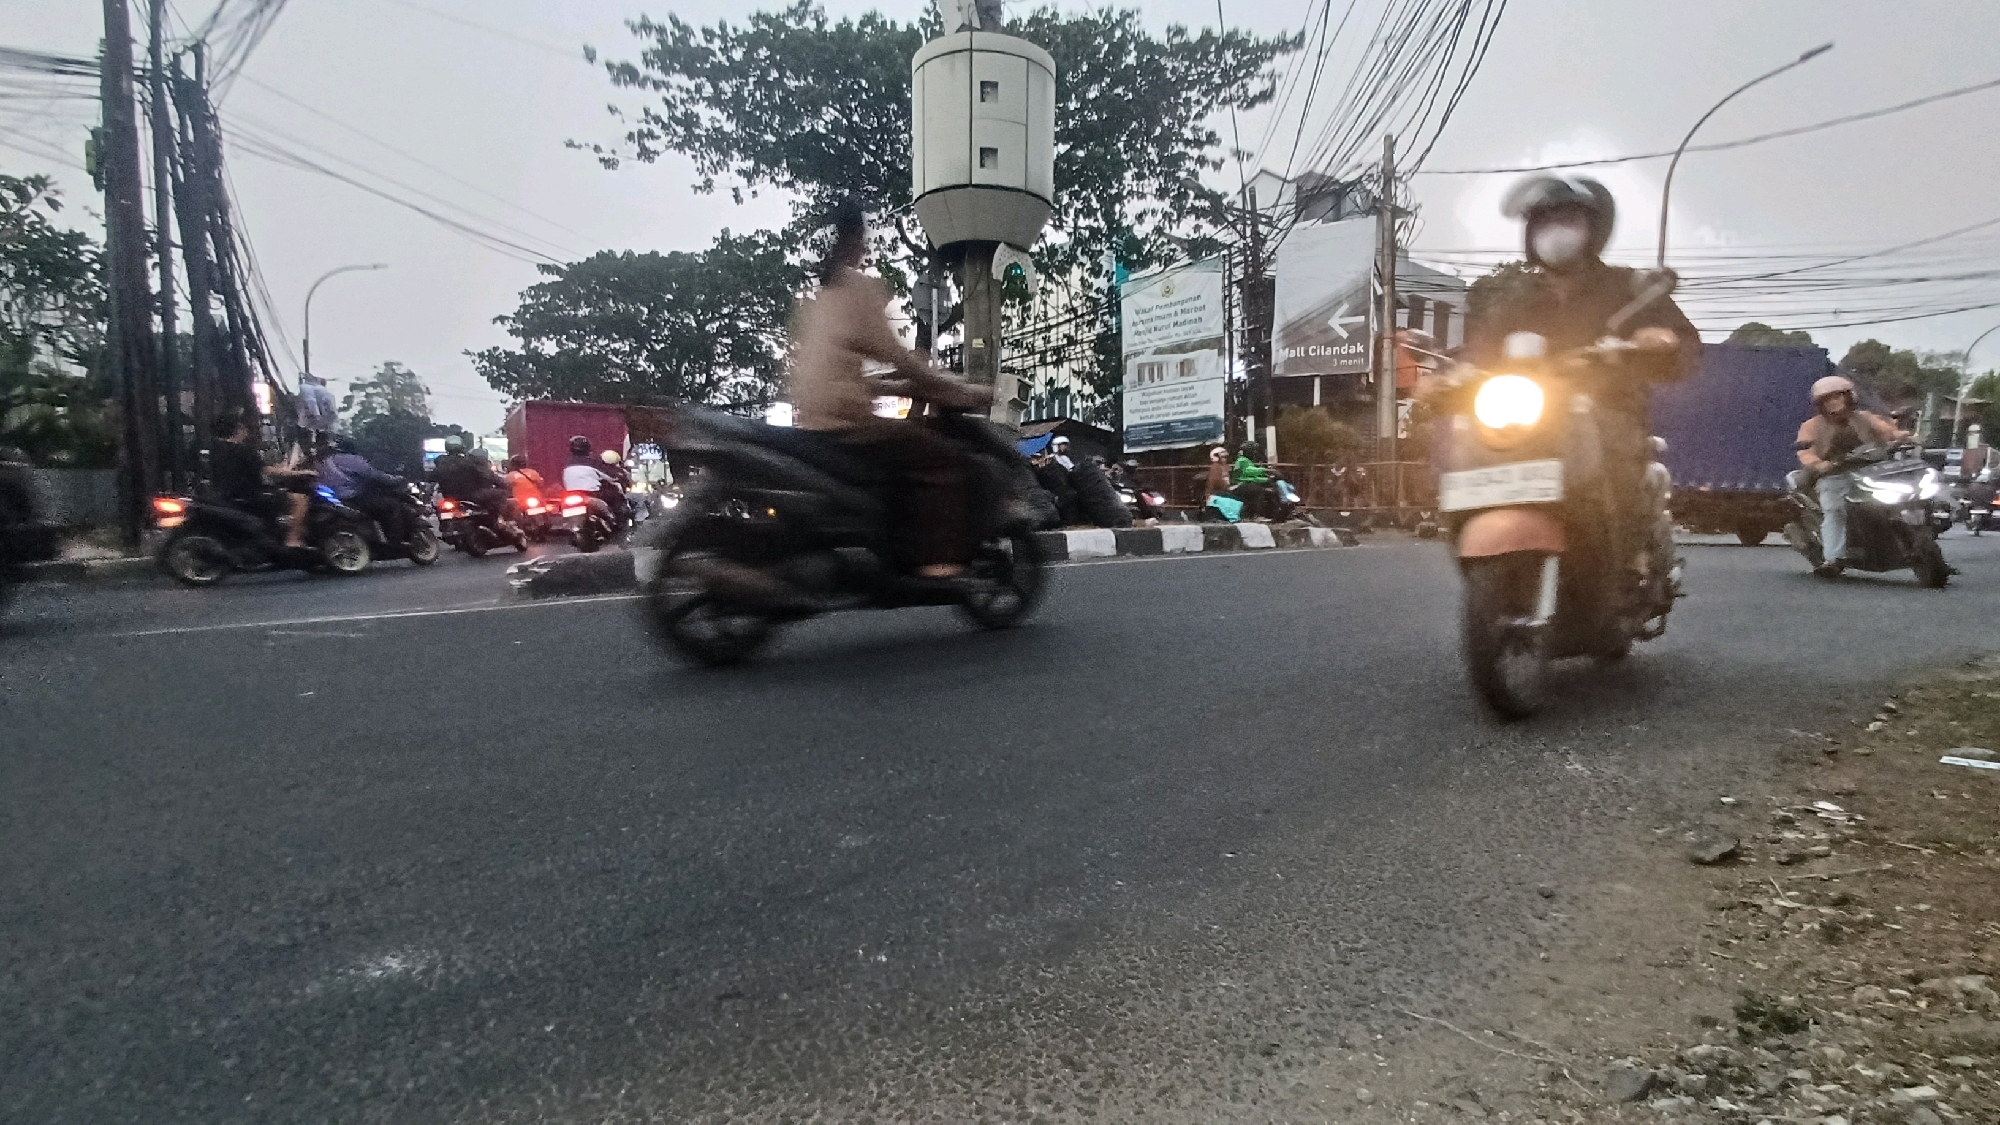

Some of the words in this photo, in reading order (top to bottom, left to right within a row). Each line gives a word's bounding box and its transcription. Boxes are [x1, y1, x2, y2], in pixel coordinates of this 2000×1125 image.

[1134, 305, 1154, 316] Wakaf
[1155, 294, 1202, 310] Pembangunan
[1154, 312, 1173, 321] Imam
[1180, 304, 1206, 315] Marbot
[1134, 327, 1152, 337] Masjid
[1153, 323, 1171, 333] Nurul
[1172, 316, 1203, 328] Madinah
[1278, 345, 1305, 358] Mall
[1308, 342, 1364, 356] Cilandak
[1332, 358, 1338, 367] 3
[1340, 357, 1364, 366] menit
